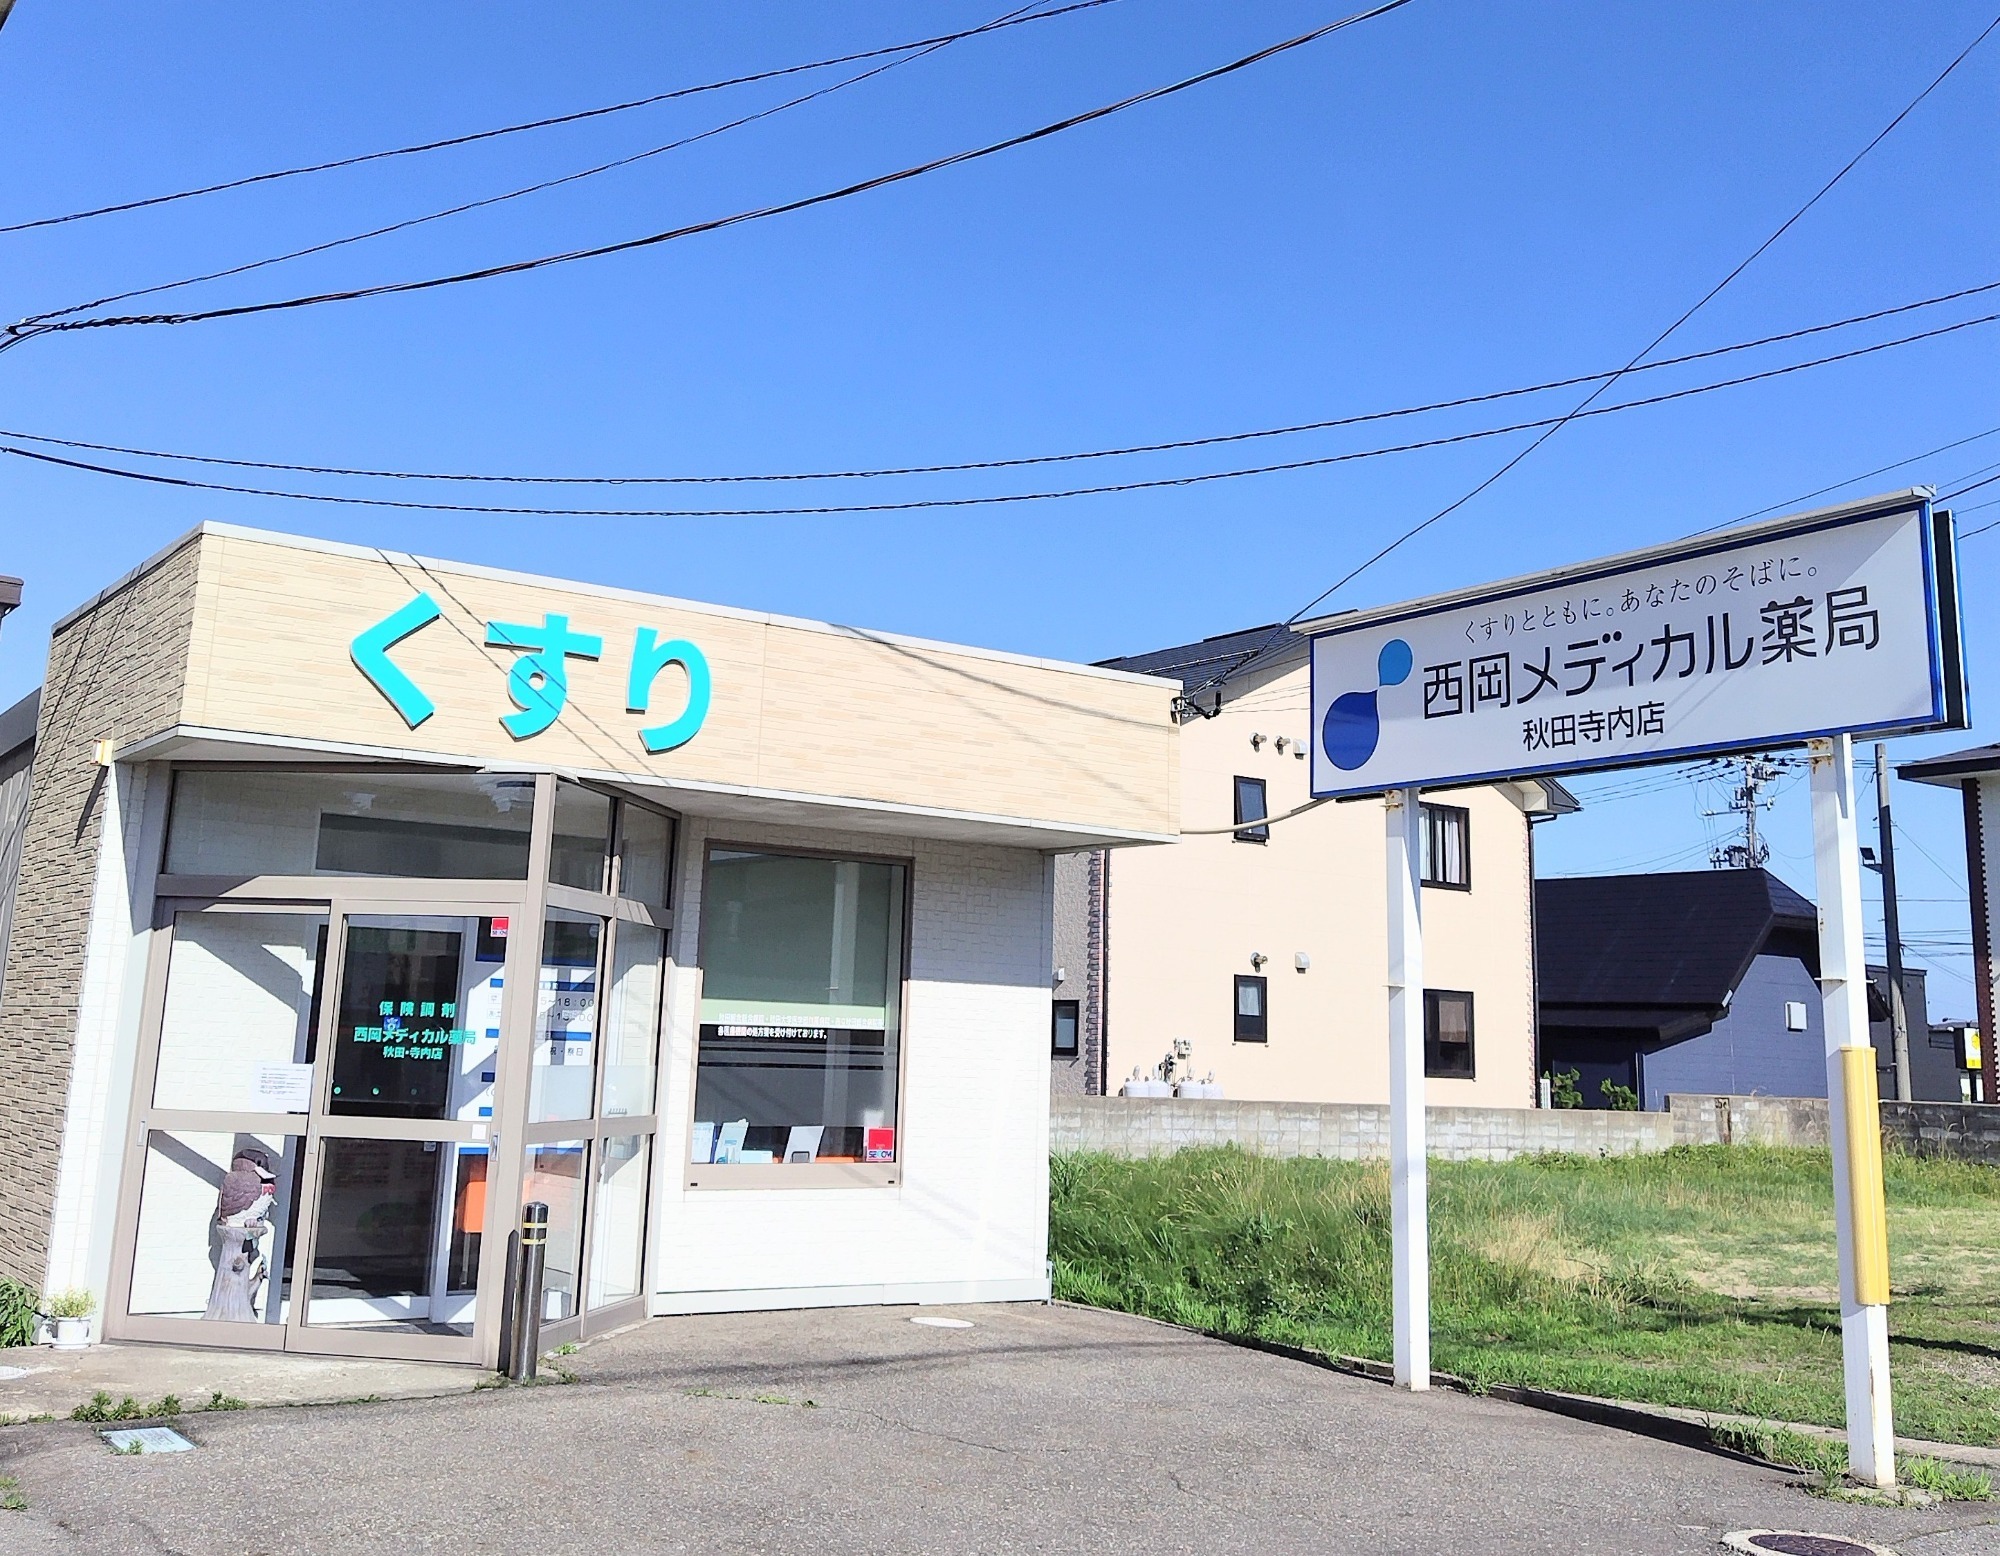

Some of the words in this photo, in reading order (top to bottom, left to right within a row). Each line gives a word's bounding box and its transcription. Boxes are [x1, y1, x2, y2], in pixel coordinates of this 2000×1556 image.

[1463, 555, 1818, 645] くすりとともに。あなたのそばに。
[349, 591, 712, 754] くすり
[1423, 585, 1880, 721] 西岡メディカル薬局
[1522, 701, 1666, 752] 秋田寺内店
[353, 1026, 476, 1045] 西岡メディカル薬局
[382, 1046, 443, 1060] 秋田・寺内店
